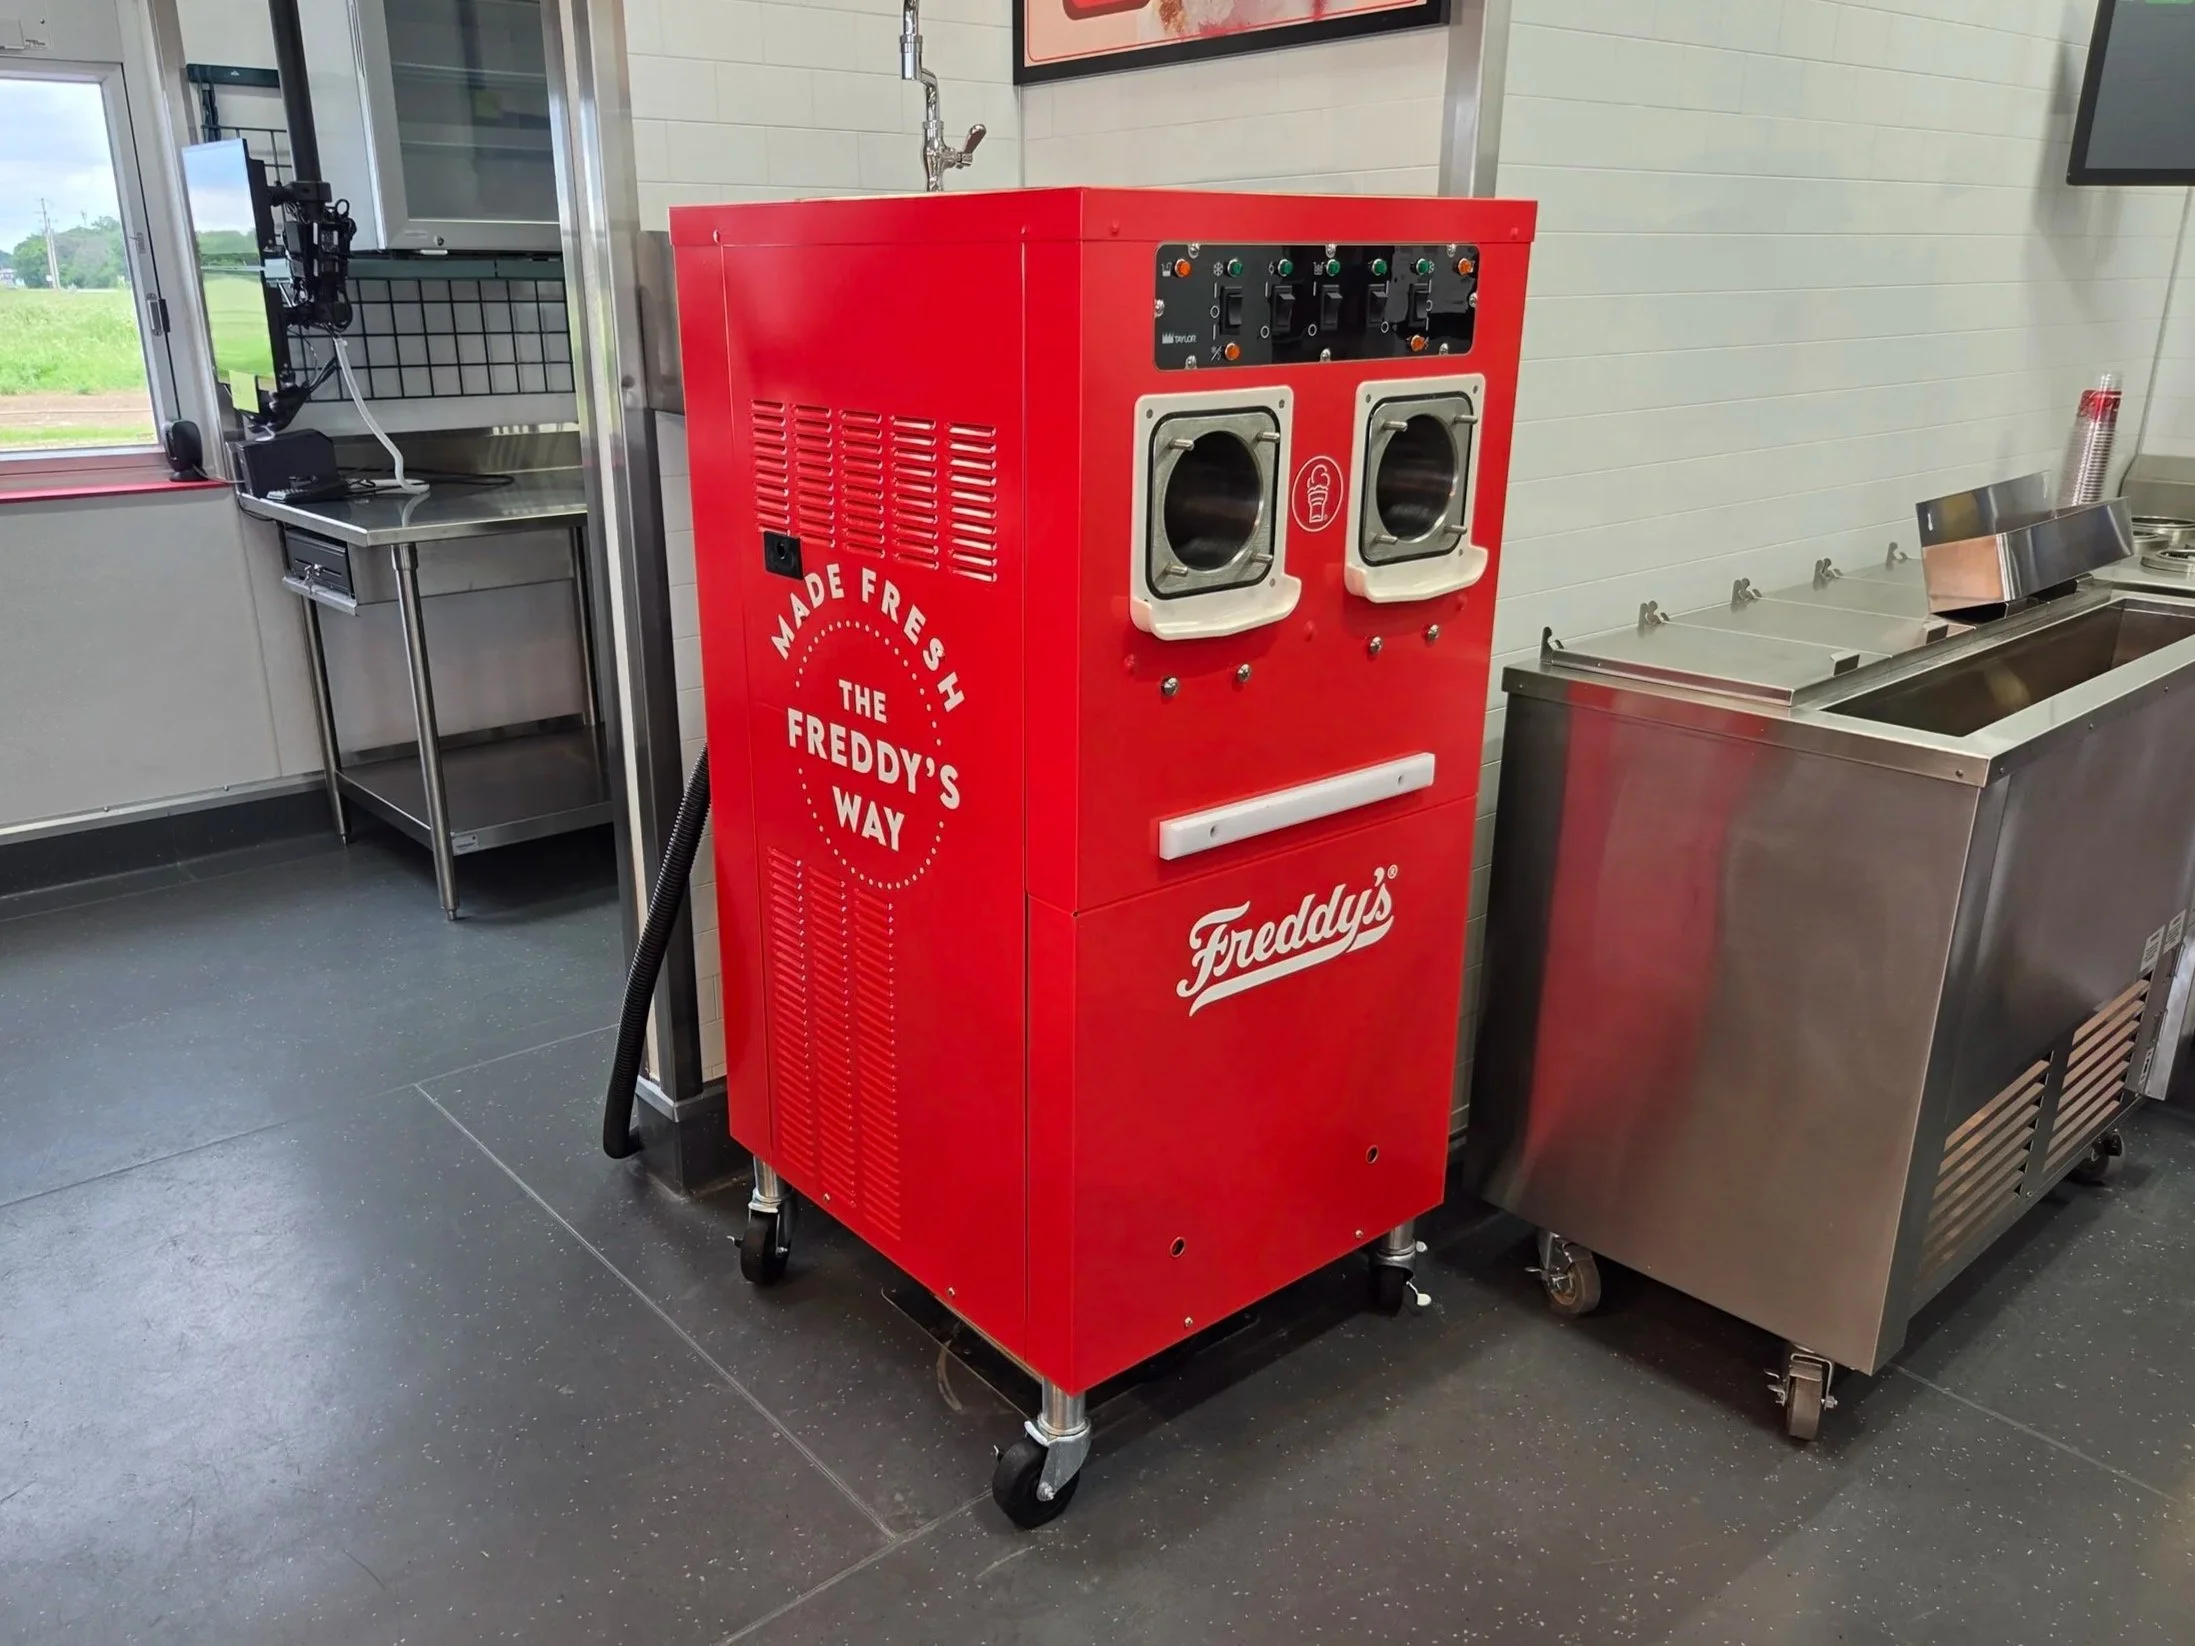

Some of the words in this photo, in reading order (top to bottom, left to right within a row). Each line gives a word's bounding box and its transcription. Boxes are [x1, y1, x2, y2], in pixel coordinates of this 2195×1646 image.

[1174, 334, 1198, 344] TAYLOR
[771, 563, 845, 660] MADE
[861, 567, 965, 712] FRESH
[838, 679, 887, 724] THE
[787, 707, 960, 810] FREDDY'S
[832, 785, 905, 852] WAY
